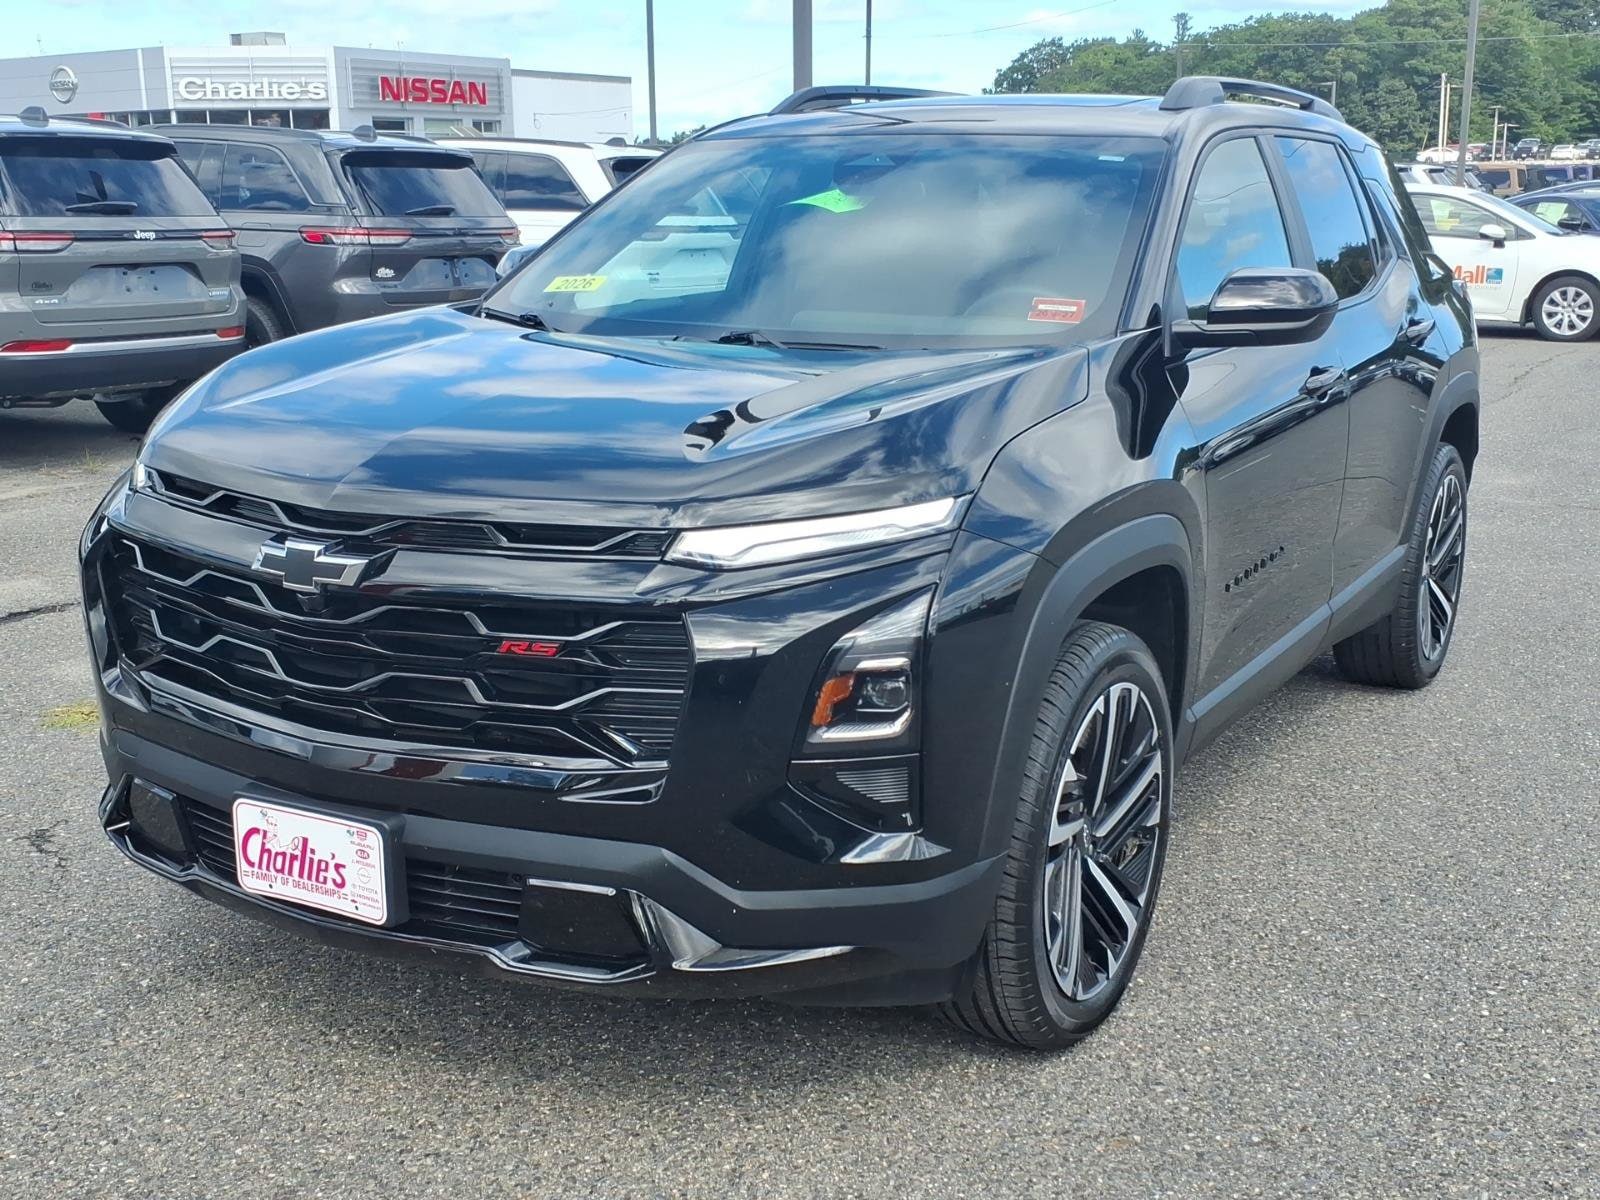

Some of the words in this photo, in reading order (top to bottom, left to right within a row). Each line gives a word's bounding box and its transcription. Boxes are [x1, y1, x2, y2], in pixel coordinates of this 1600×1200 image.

[178, 76, 327, 100] Charlie's
[379, 75, 489, 105] NISSAN
[133, 230, 156, 240] Jeep
[555, 277, 597, 290] 2026
[498, 640, 560, 656] RS
[241, 826, 347, 890] Charlie's
[251, 869, 279, 884] FAMILY
[280, 876, 290, 887] OF
[292, 878, 342, 900] DEALERSHIPS
